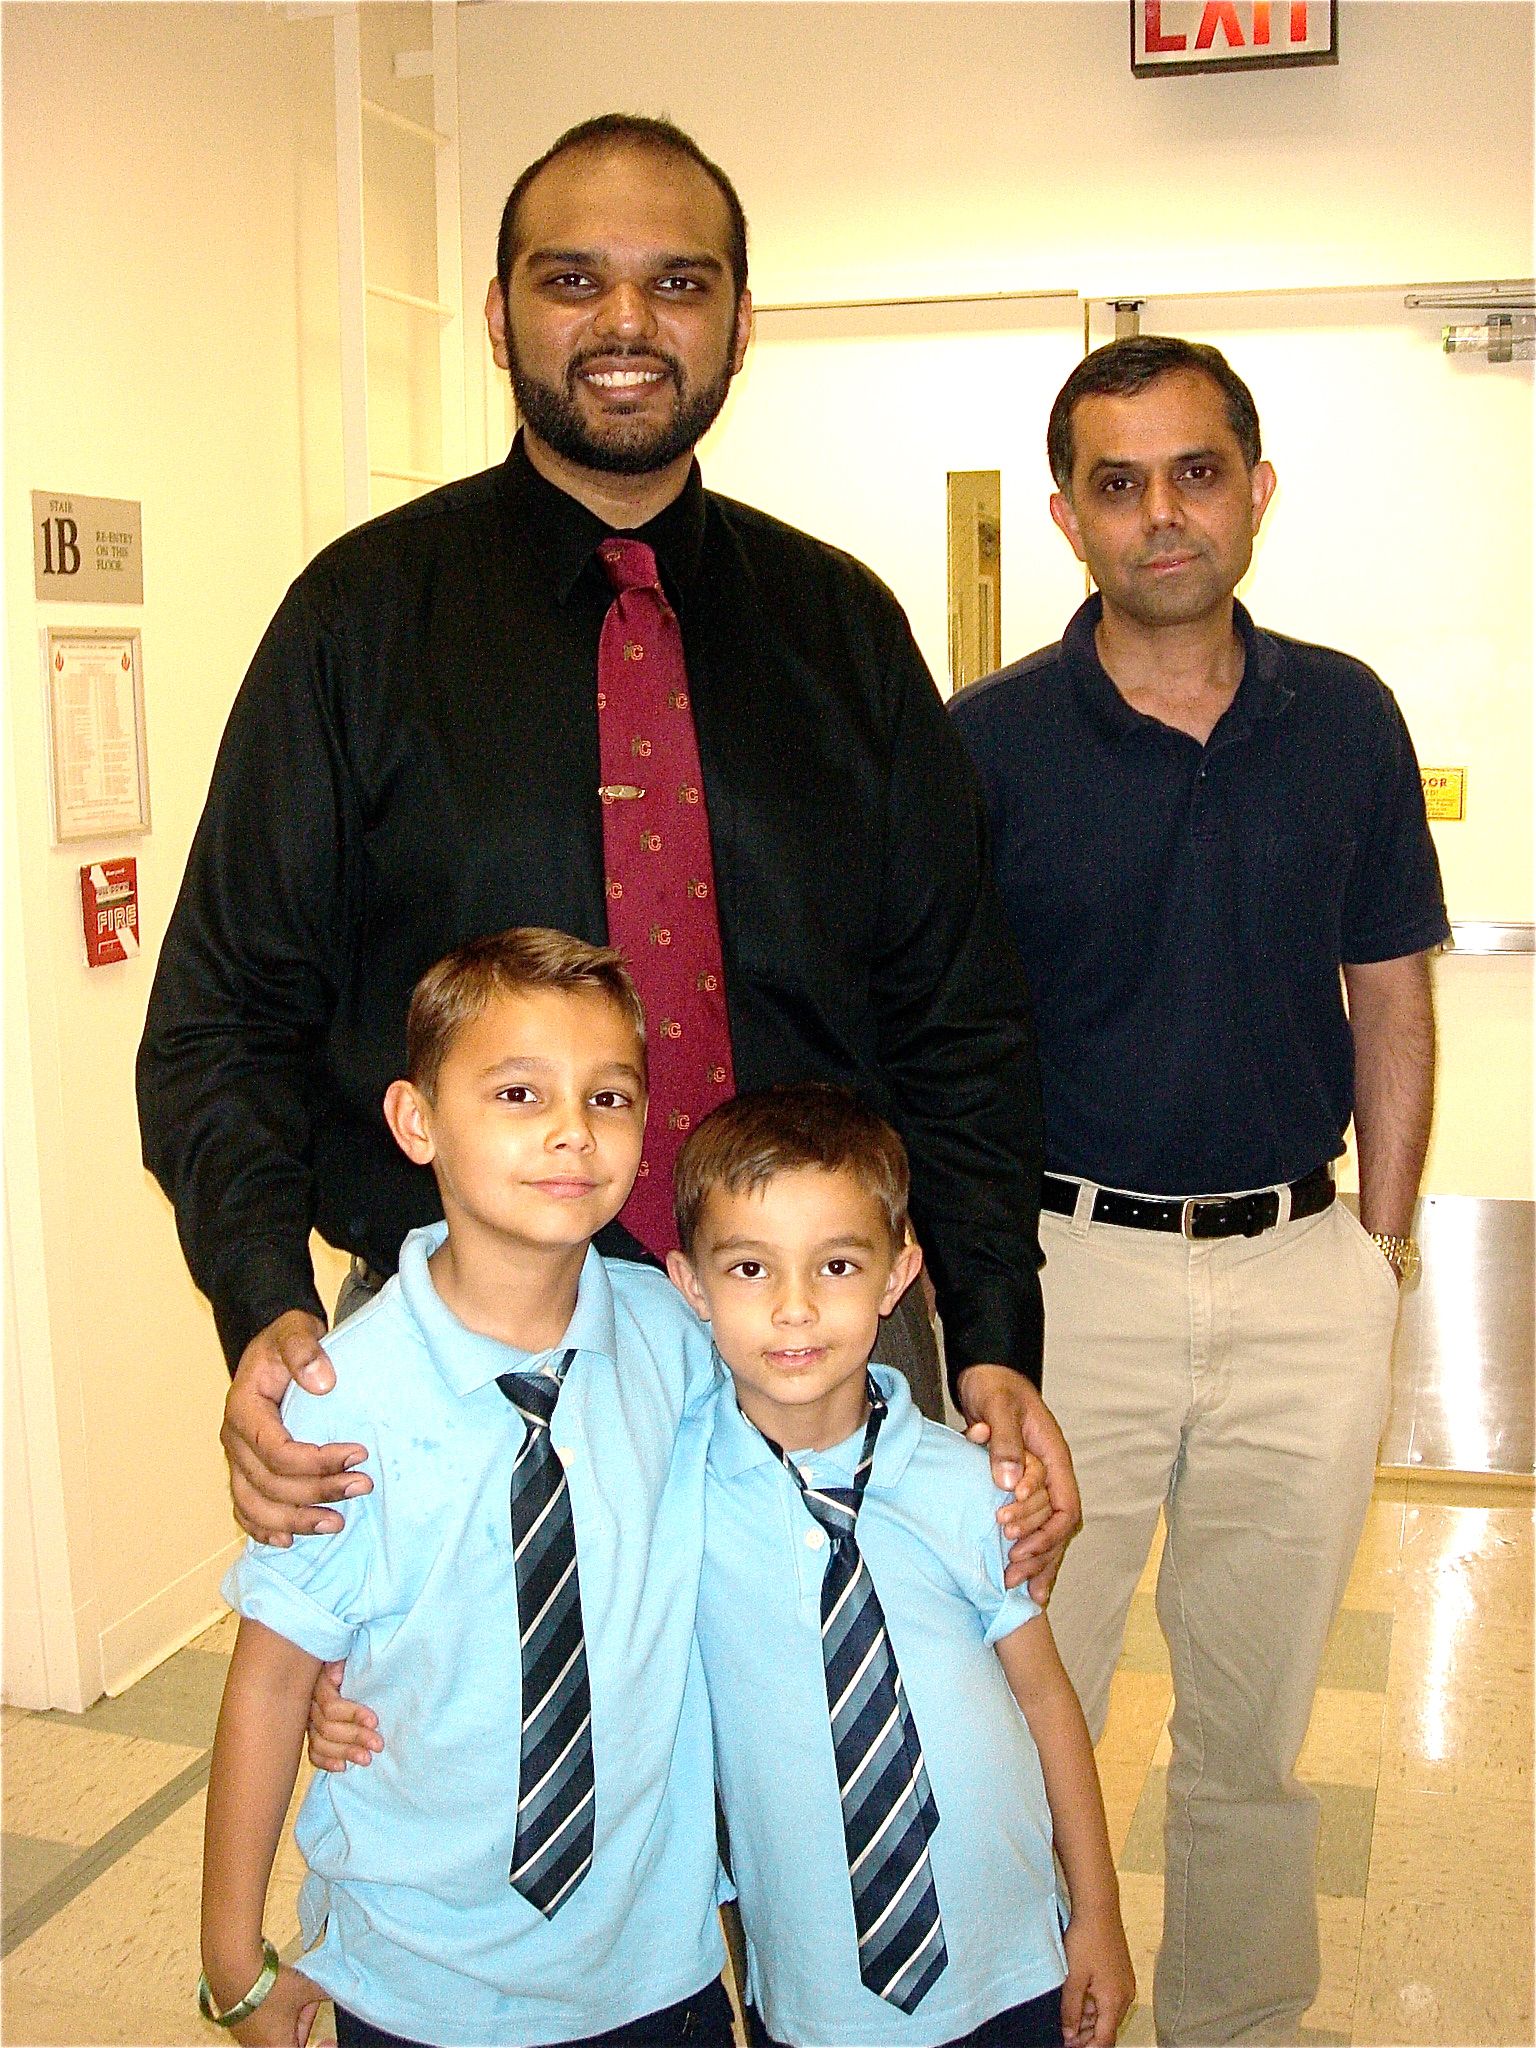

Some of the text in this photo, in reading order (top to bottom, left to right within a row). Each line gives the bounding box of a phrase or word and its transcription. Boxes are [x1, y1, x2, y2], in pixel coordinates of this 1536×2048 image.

[49, 500, 73, 513] STAIR
[41, 517, 81, 575] 1B
[96, 546, 128, 557] ON THIS
[97, 904, 137, 935] FIRE
